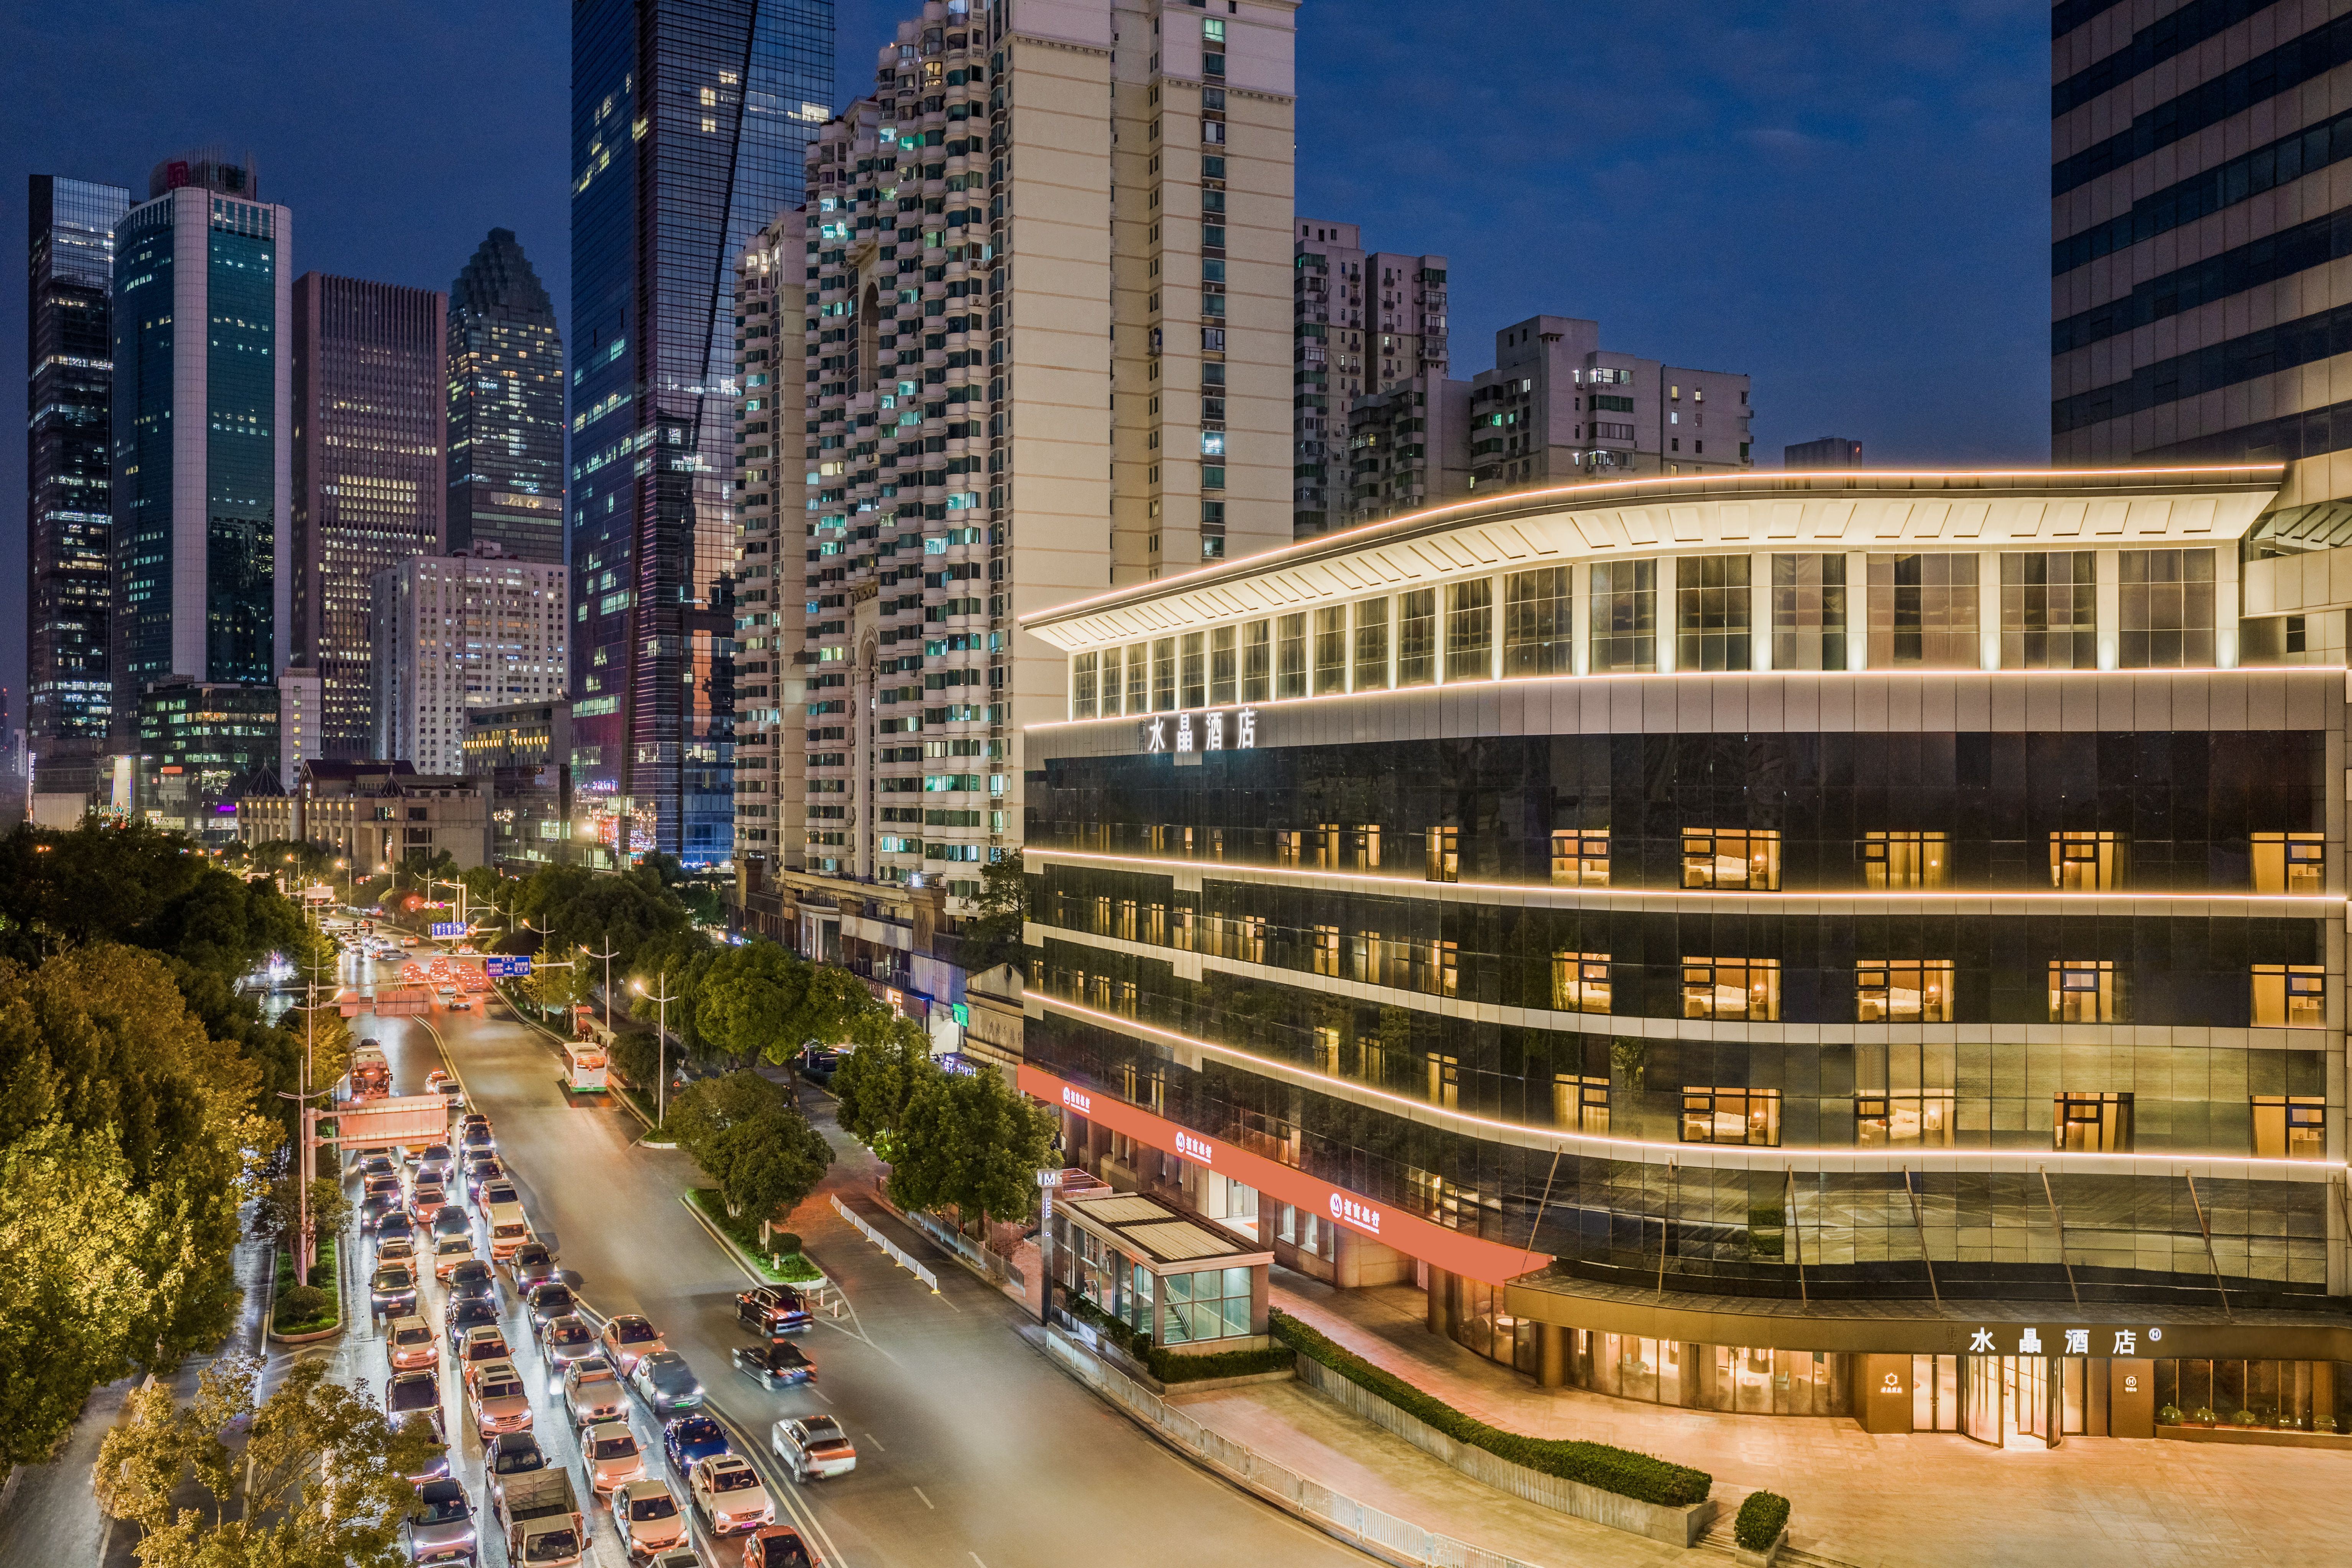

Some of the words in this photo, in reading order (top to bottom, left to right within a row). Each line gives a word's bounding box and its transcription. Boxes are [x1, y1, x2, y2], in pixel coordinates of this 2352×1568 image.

[1149, 707, 1255, 753] 水晶酒店
[1186, 1136, 1211, 1158] 招商银行
[1344, 1199, 1379, 1228] 招商银行
[1969, 1327, 2136, 1355] 水晶酒店
